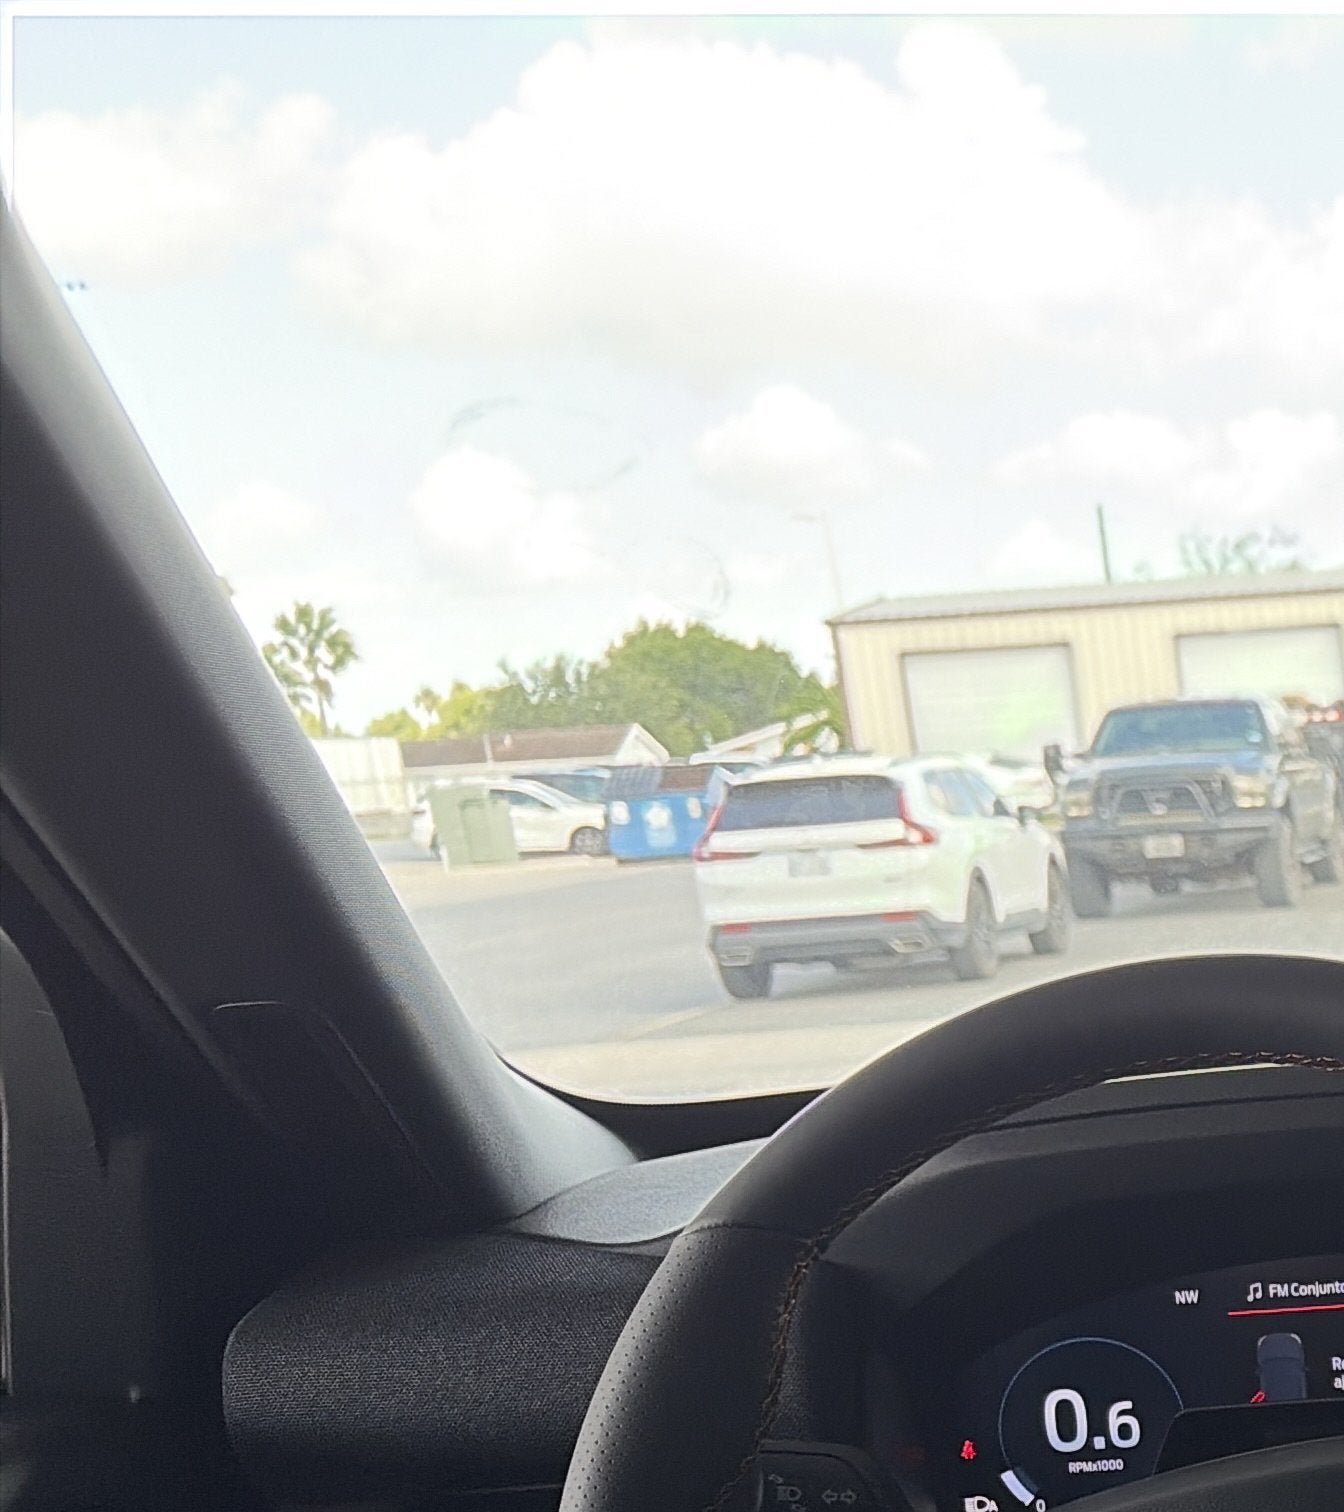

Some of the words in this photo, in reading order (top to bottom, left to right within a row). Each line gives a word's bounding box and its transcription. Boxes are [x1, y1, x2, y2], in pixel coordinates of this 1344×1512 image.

[1174, 1289, 1199, 1305] NW
[1268, 1283, 1290, 1298] FM
[1043, 1388, 1141, 1453] 0.6
[1068, 1458, 1124, 1474] RPMx1000
